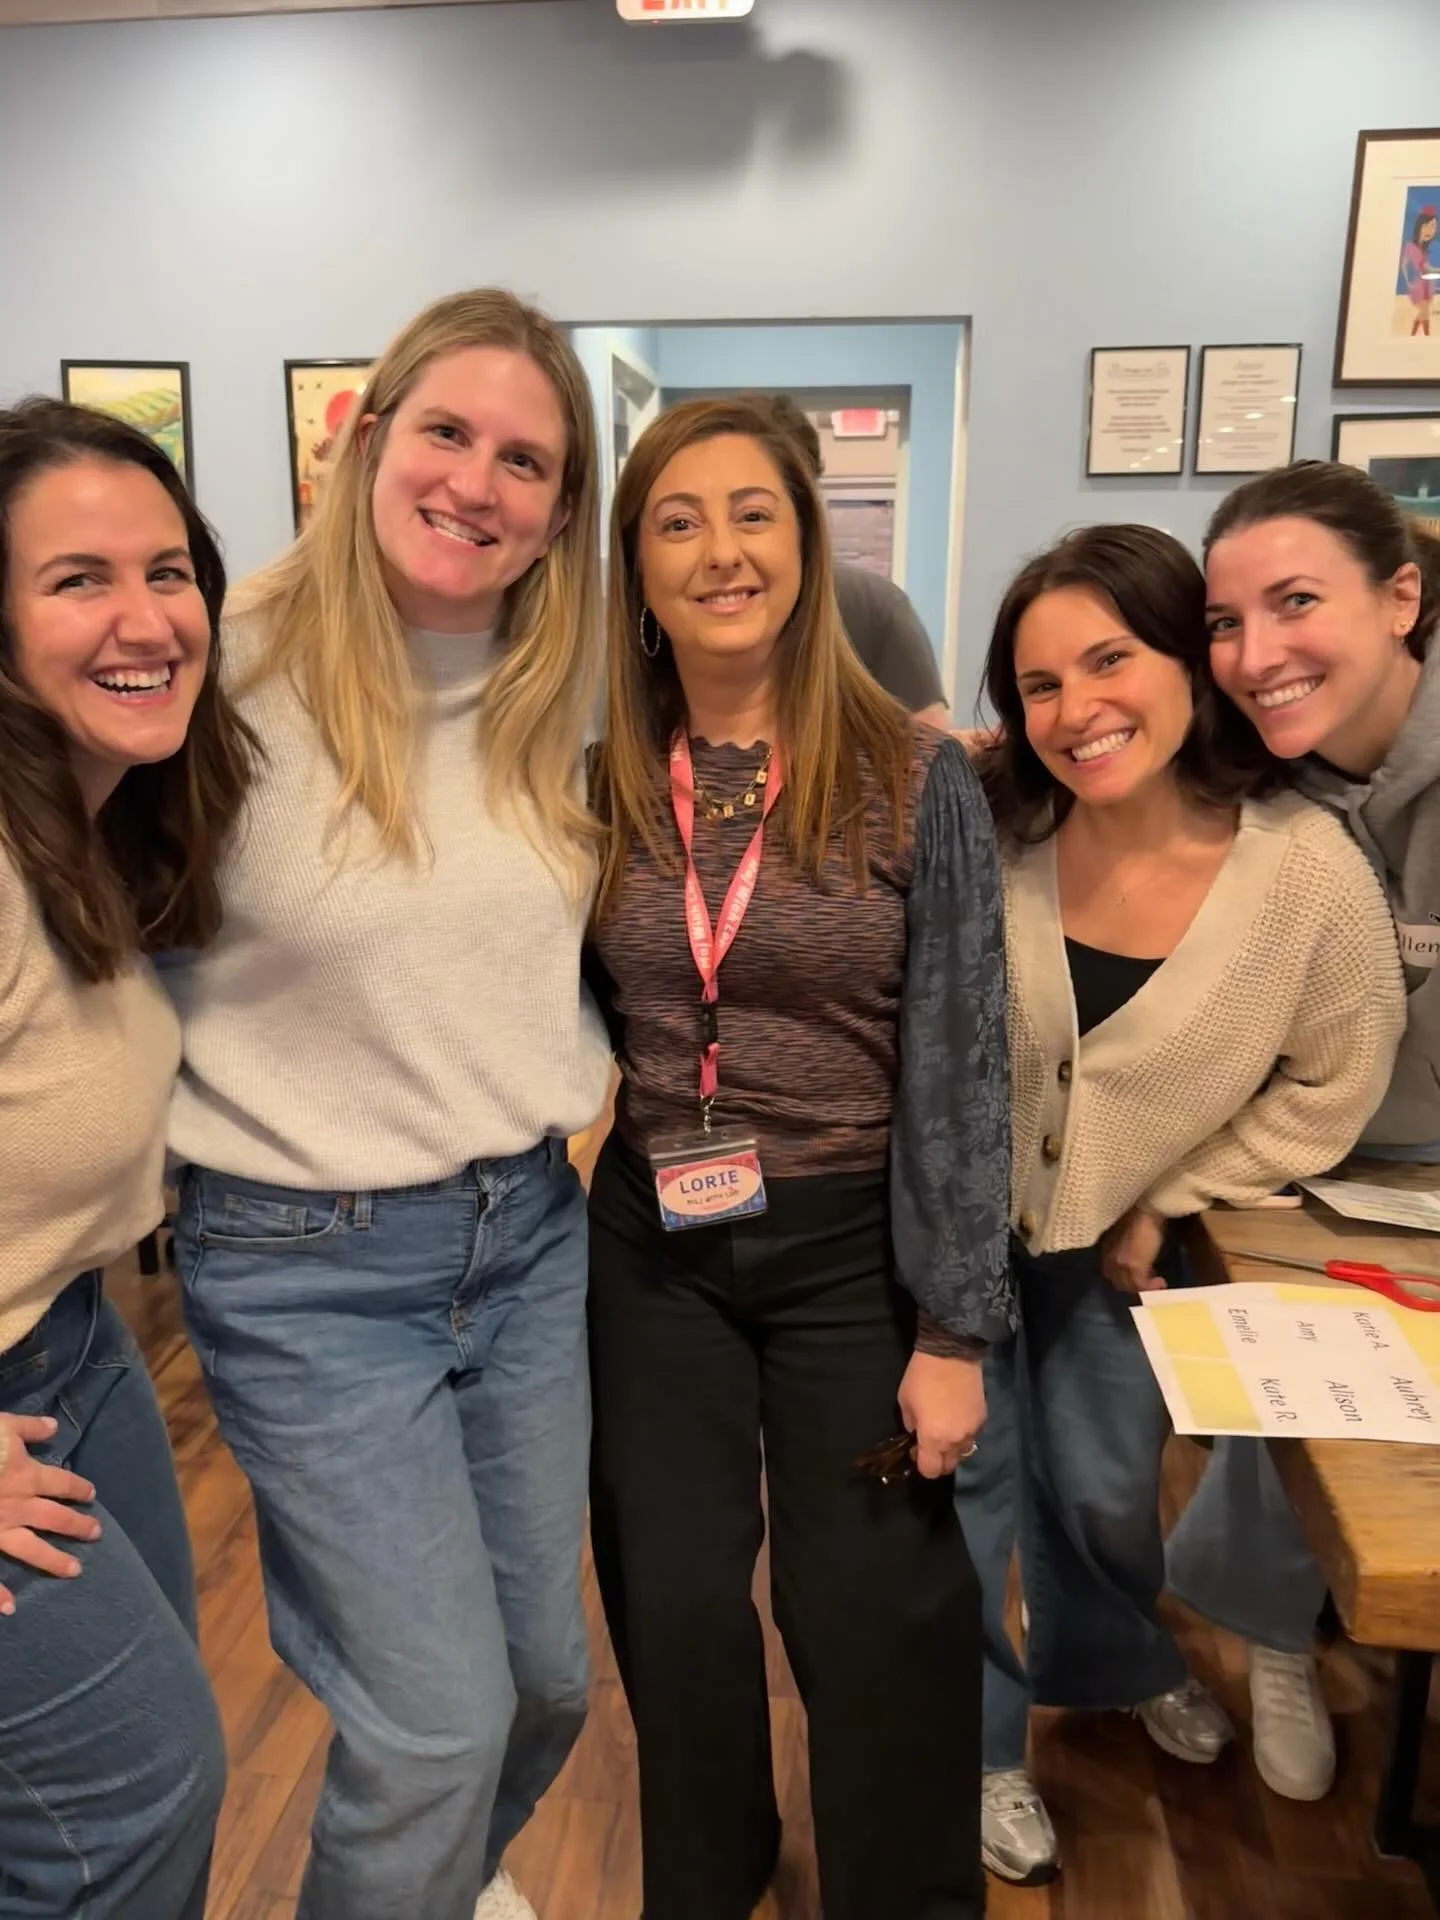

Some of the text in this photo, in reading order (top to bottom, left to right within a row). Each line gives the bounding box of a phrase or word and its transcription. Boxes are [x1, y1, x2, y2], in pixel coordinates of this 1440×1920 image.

[679, 1169, 739, 1194] LORIE
[1228, 1308, 1259, 1344] Emelie
[1296, 1320, 1318, 1343] Amy
[1352, 1311, 1380, 1339] Katie
[1260, 1378, 1287, 1406] Kate
[1325, 1379, 1363, 1422] Alison
[1390, 1376, 1436, 1423] Aubrey
